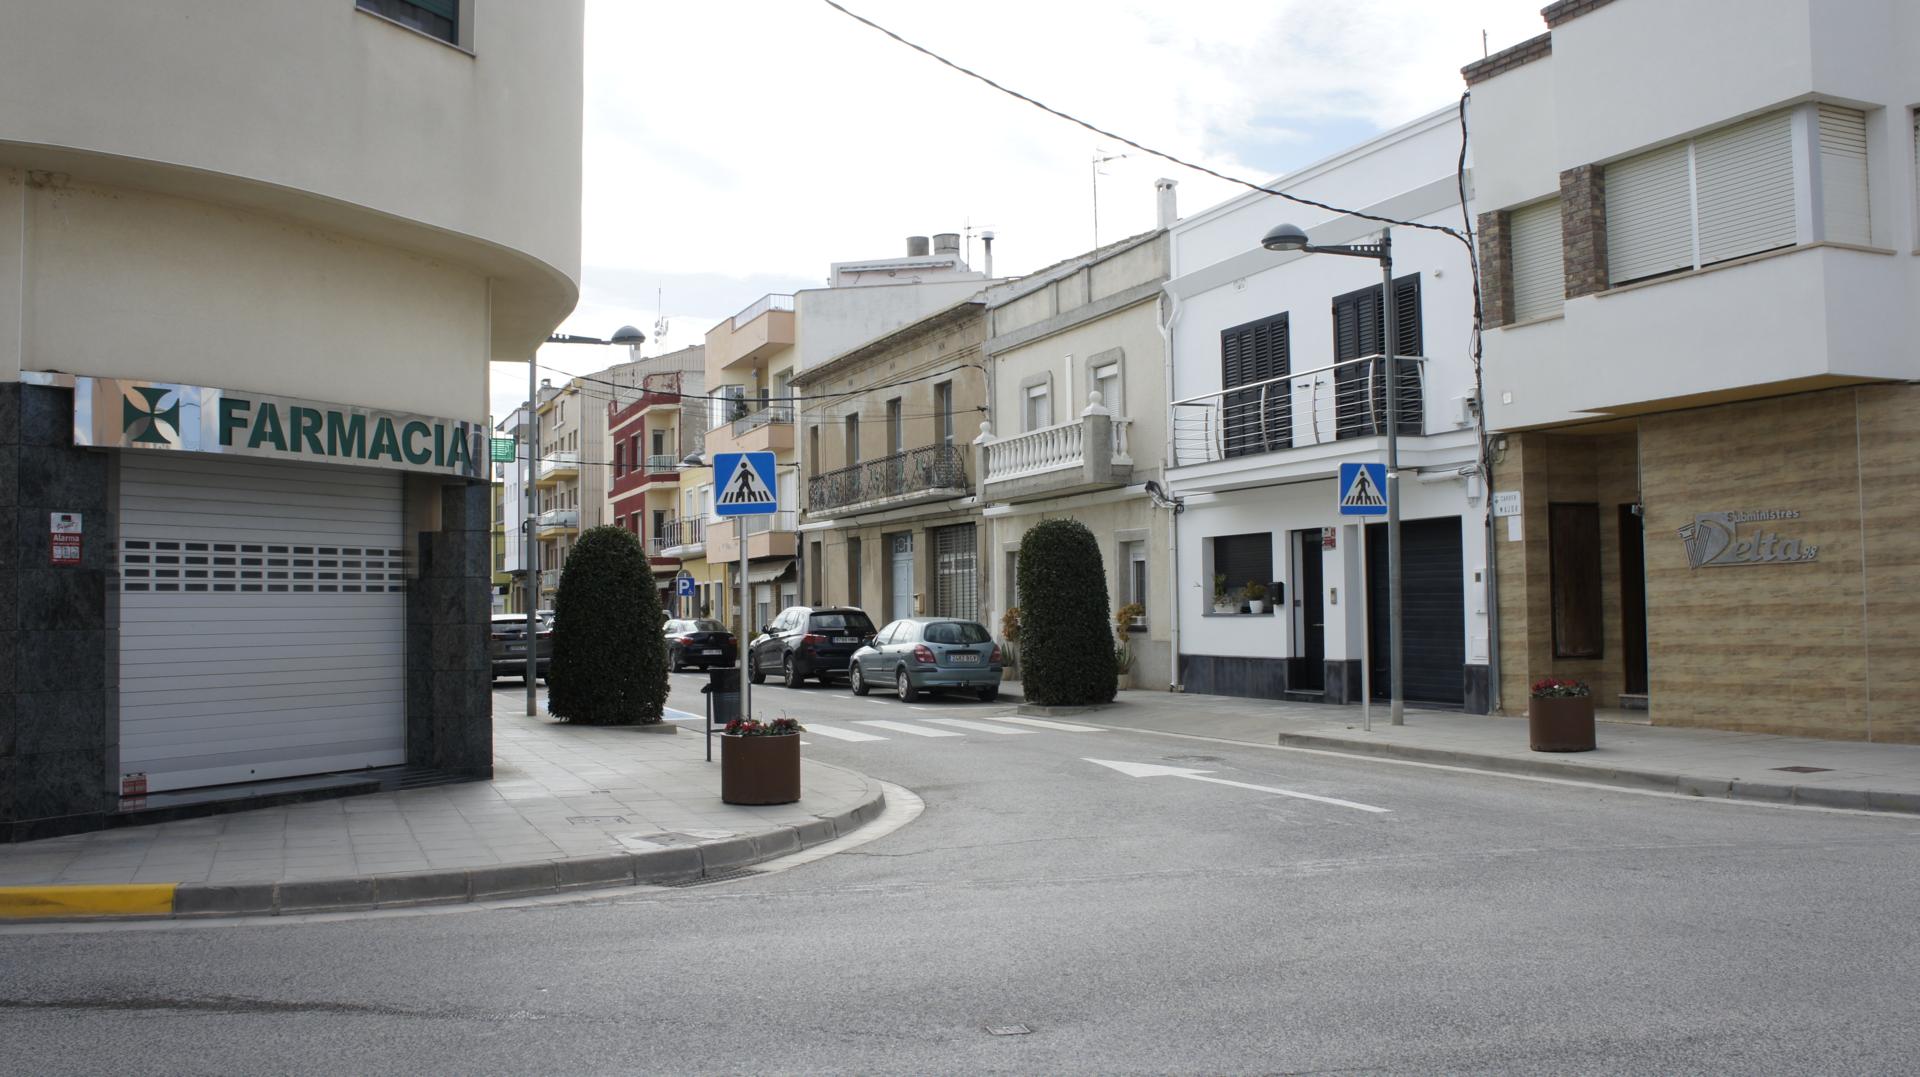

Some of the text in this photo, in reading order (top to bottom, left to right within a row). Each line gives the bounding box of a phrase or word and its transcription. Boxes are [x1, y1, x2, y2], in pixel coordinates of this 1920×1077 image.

[219, 397, 472, 470] FARMACIA
[1727, 510, 1799, 522] Subministres
[53, 534, 80, 542] Alarma
[1696, 519, 1802, 563] Delta
[680, 579, 690, 594] P
